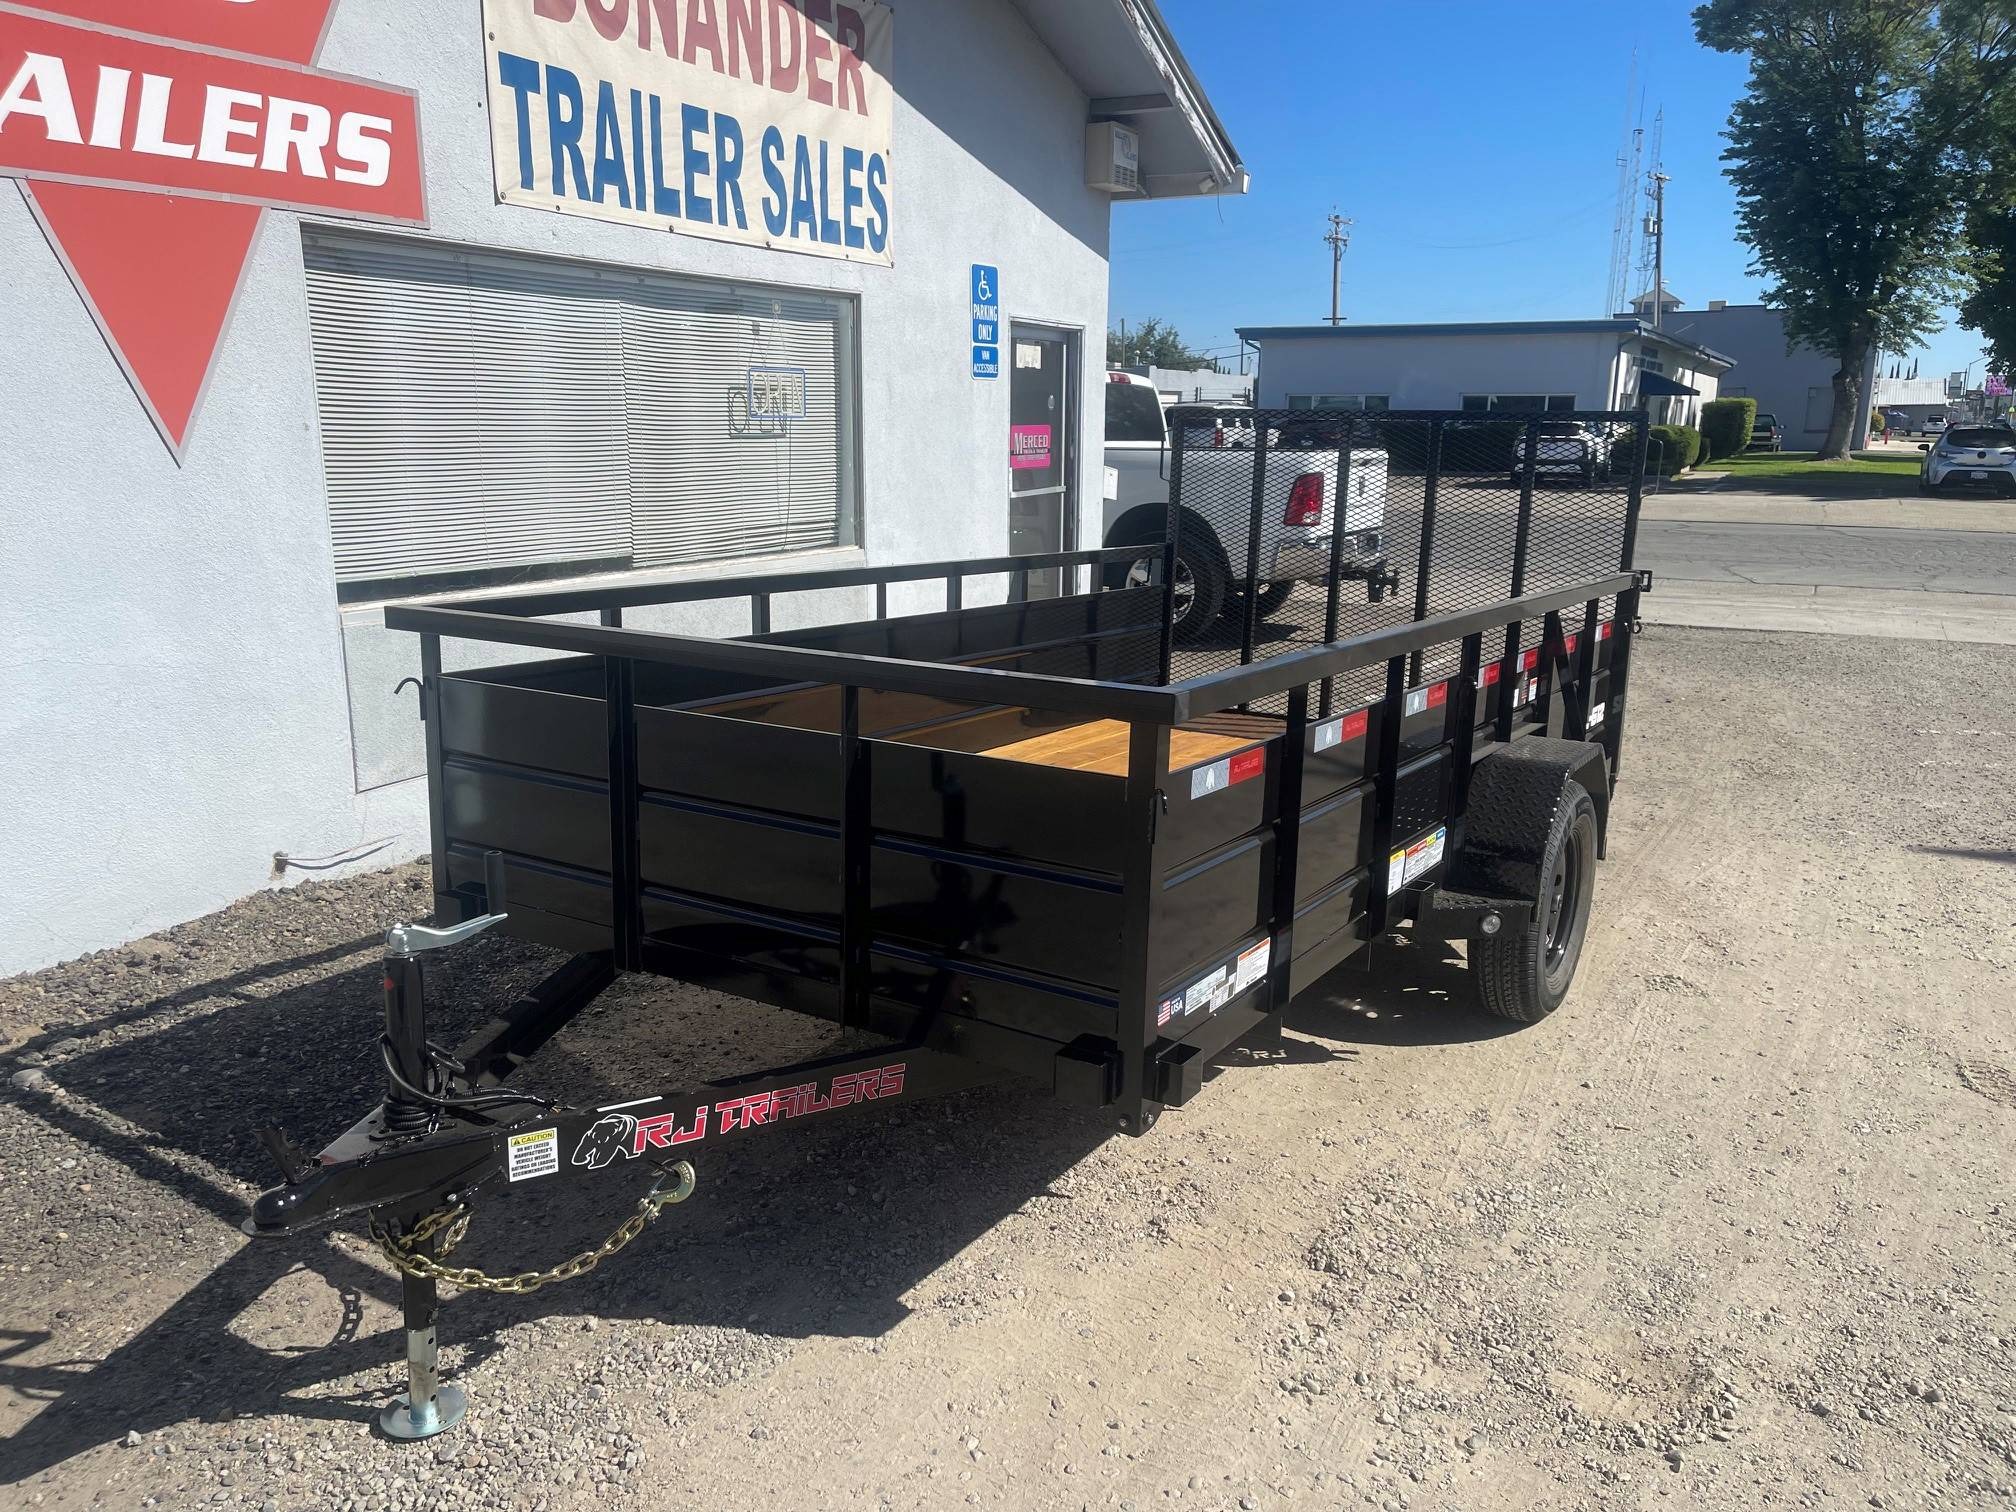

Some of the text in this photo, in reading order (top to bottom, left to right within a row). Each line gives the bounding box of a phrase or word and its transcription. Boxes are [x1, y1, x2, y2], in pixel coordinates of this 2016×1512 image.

[498, 51, 888, 253] TRAILER SALES
[973, 304, 998, 321] PARKING
[978, 324, 993, 341] ONLY
[973, 363, 998, 374] ACCESSIBLE
[633, 1063, 906, 1154] RJ TRAILERS
[521, 1132, 553, 1143] CAUTION
